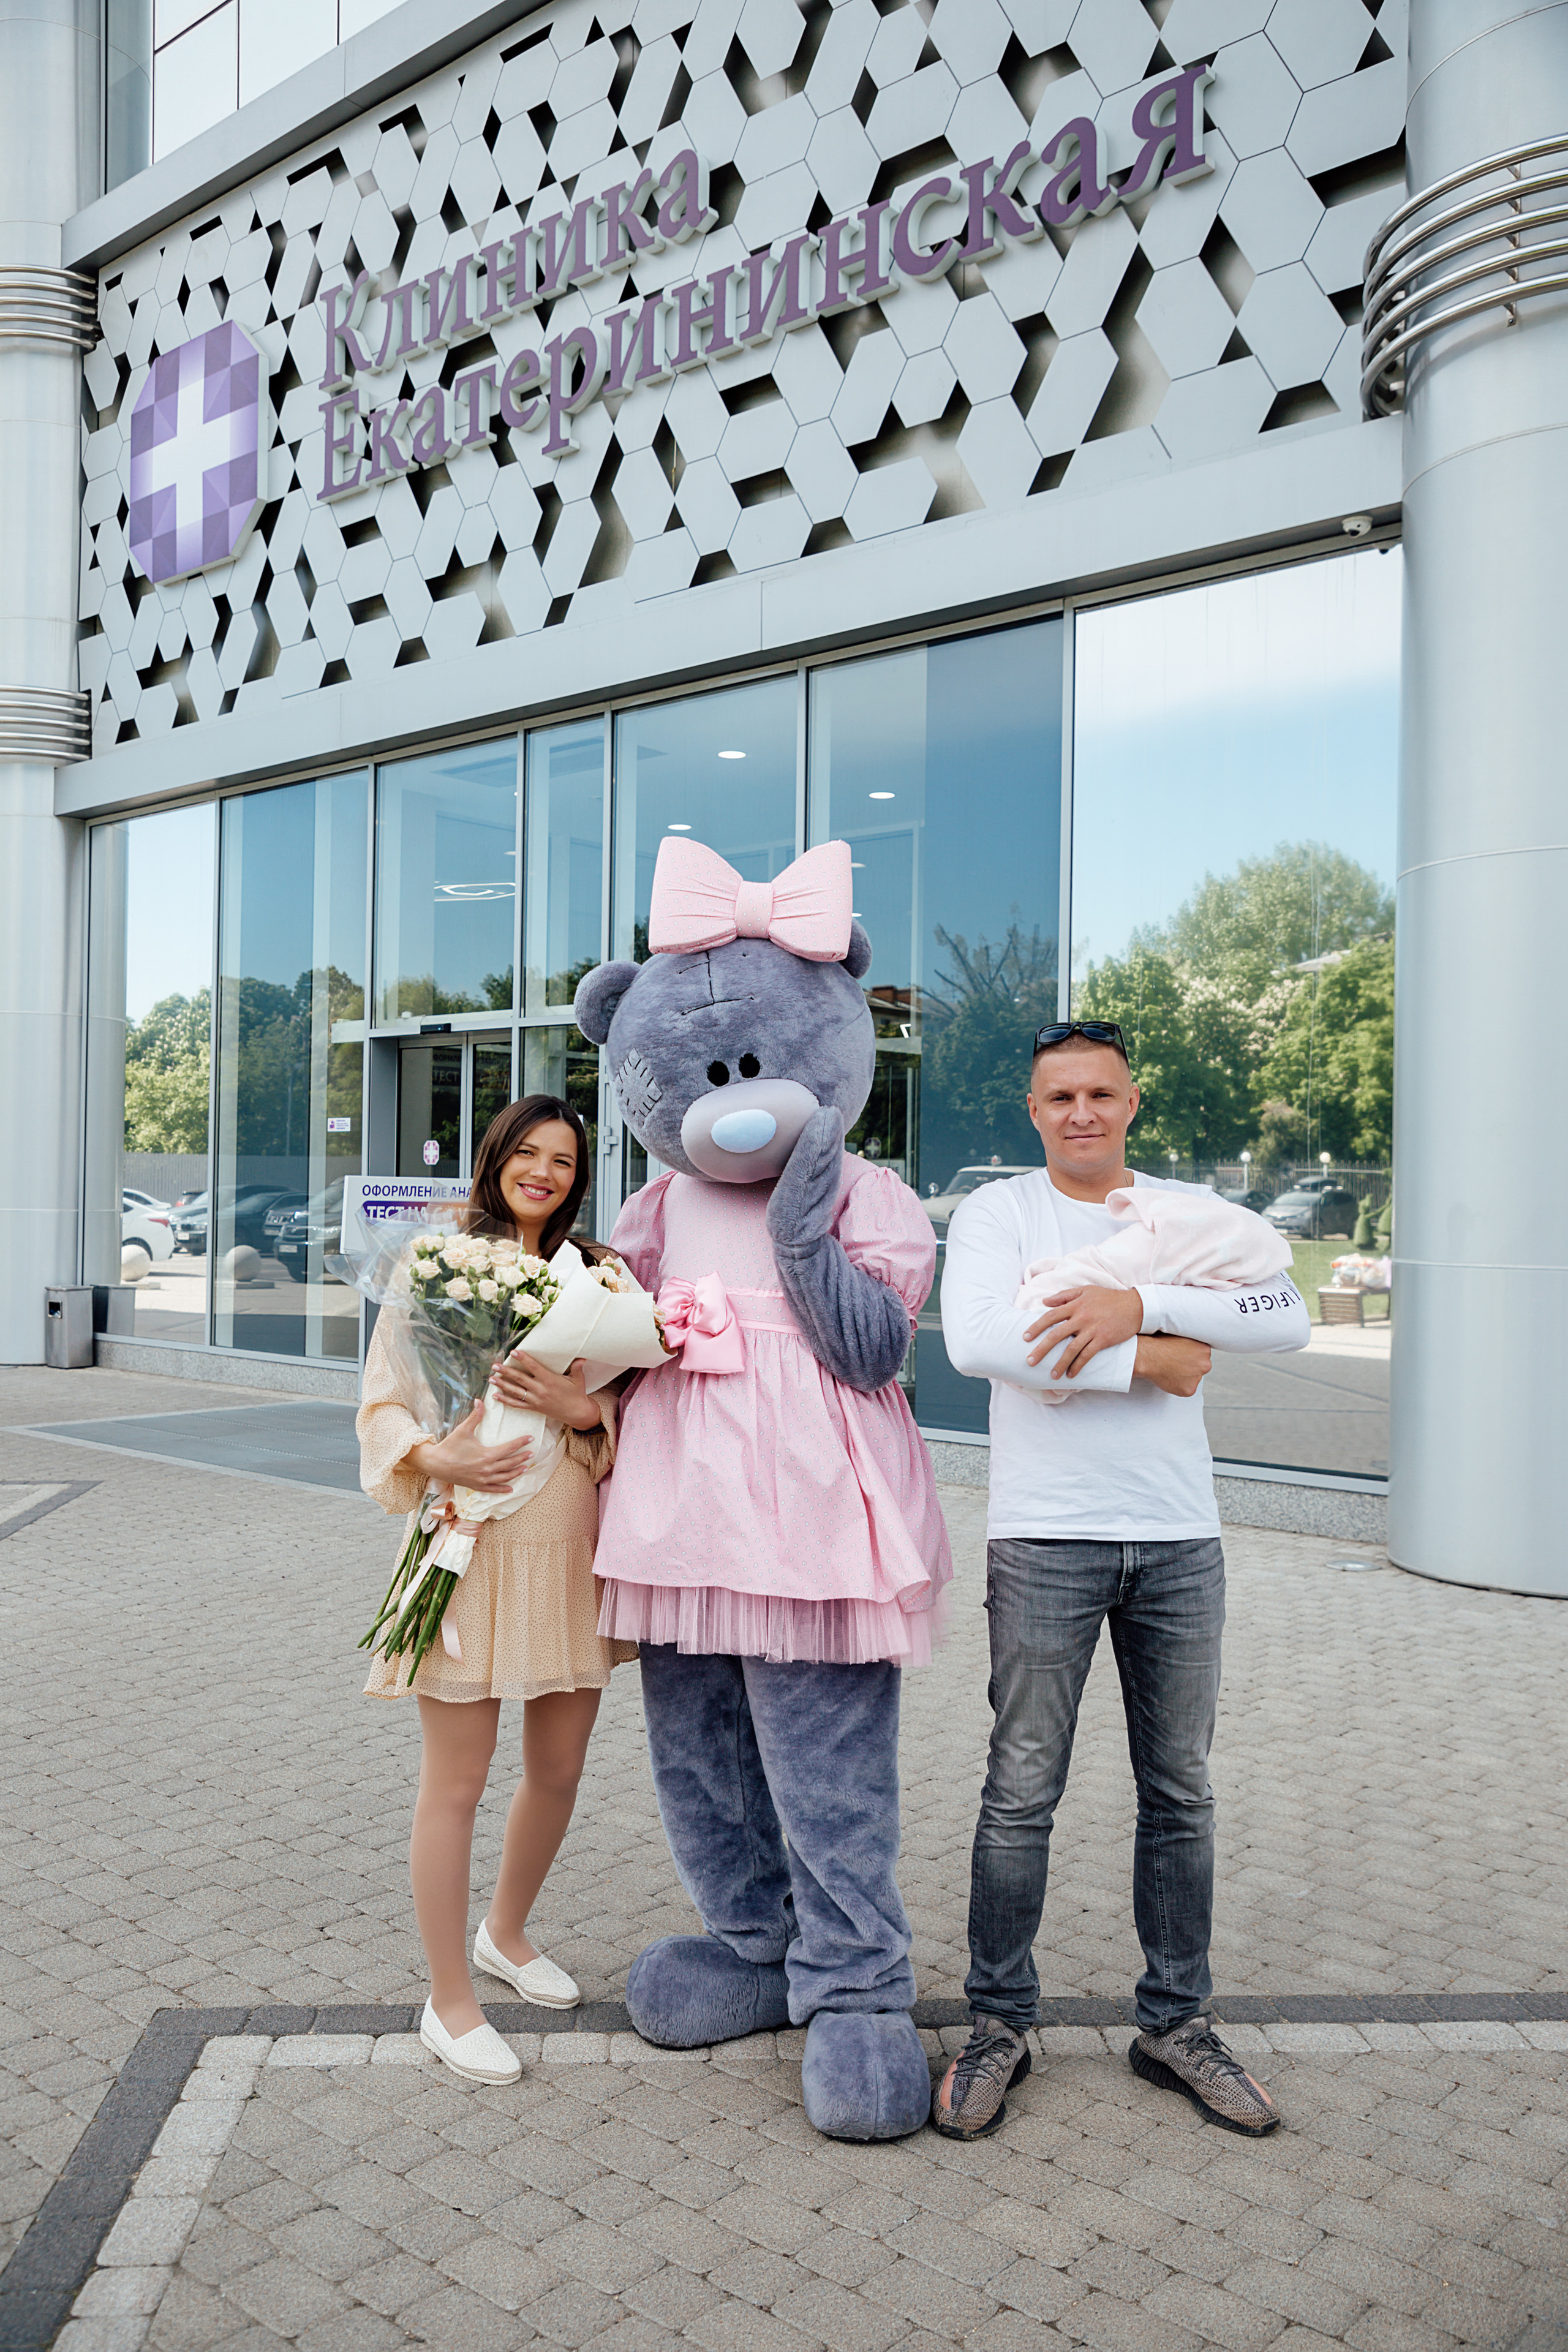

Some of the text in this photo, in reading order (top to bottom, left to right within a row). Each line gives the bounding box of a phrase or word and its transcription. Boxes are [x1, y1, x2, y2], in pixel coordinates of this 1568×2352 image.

[316, 62, 1214, 502] Екатерининская
[318, 148, 717, 393] Клиника
[362, 1184, 447, 1198] ОФОРМЛЕНИЕ
[367, 1205, 404, 1221] ТЕСТ
